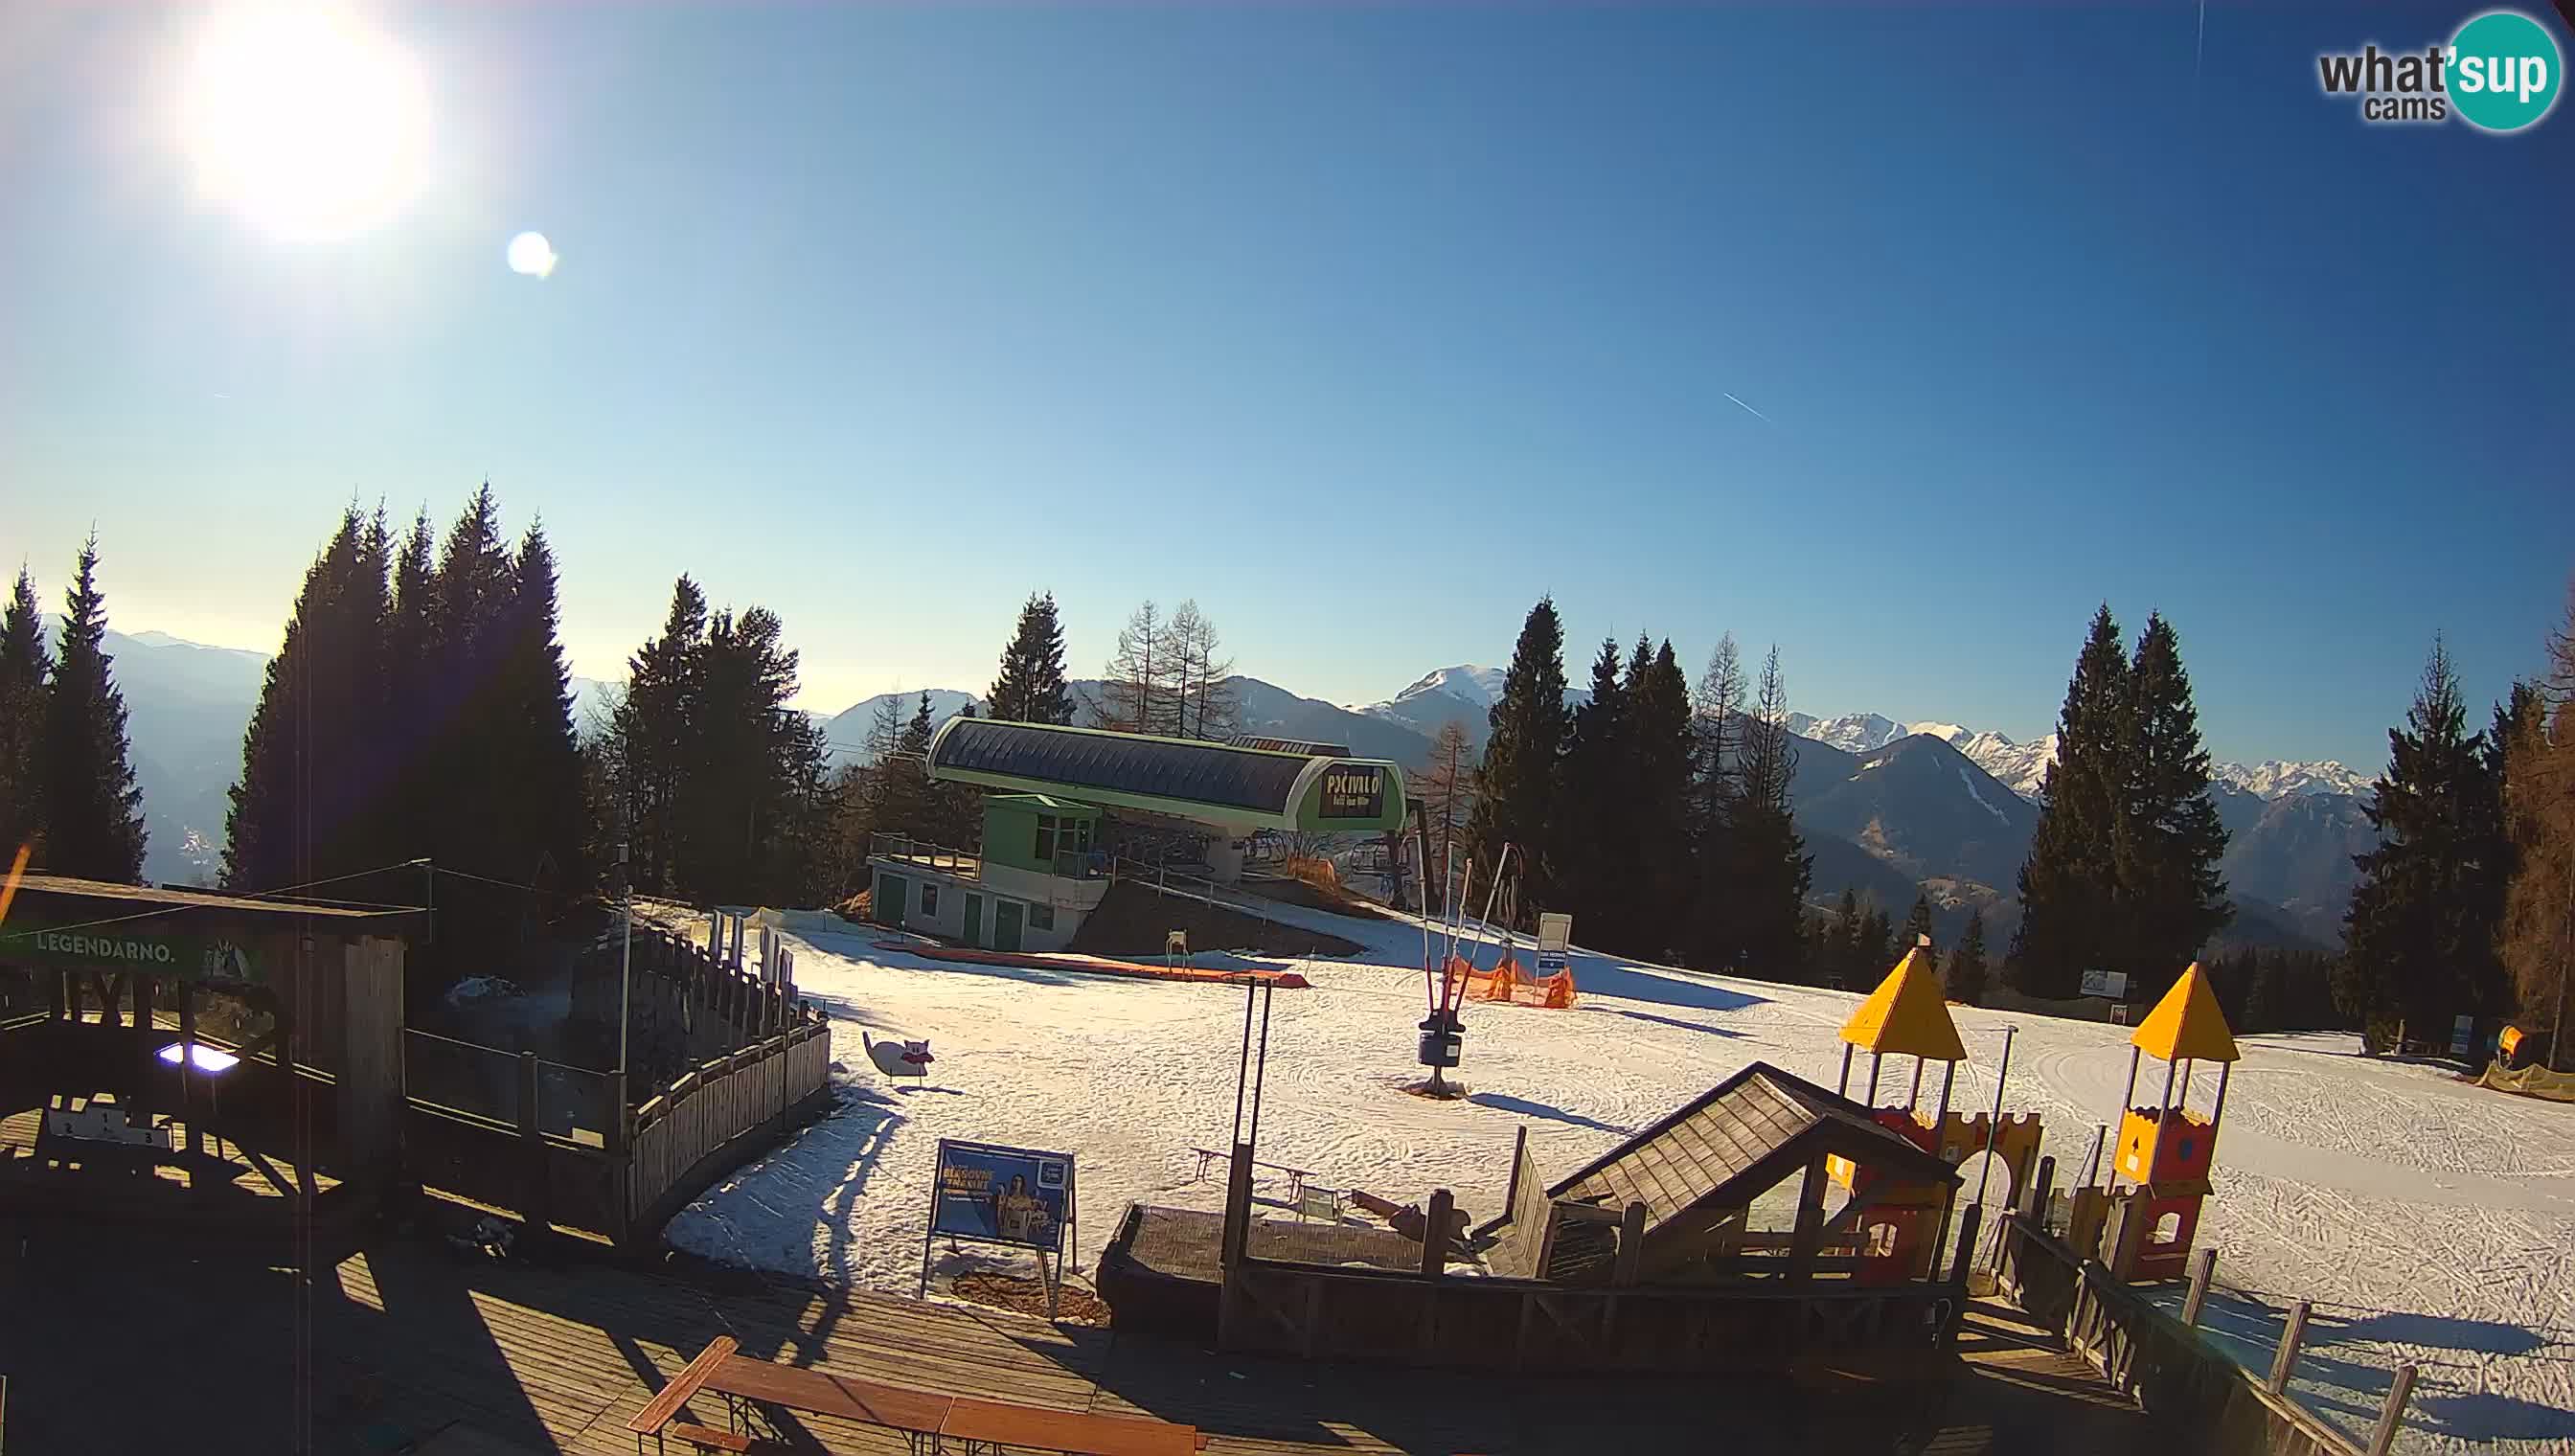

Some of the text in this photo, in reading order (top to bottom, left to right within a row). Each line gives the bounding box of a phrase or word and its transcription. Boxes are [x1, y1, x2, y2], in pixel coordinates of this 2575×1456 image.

[36, 932, 175, 963] LEGENDARNO.
[102, 1111, 108, 1124] 1
[145, 1132, 153, 1144] 3
